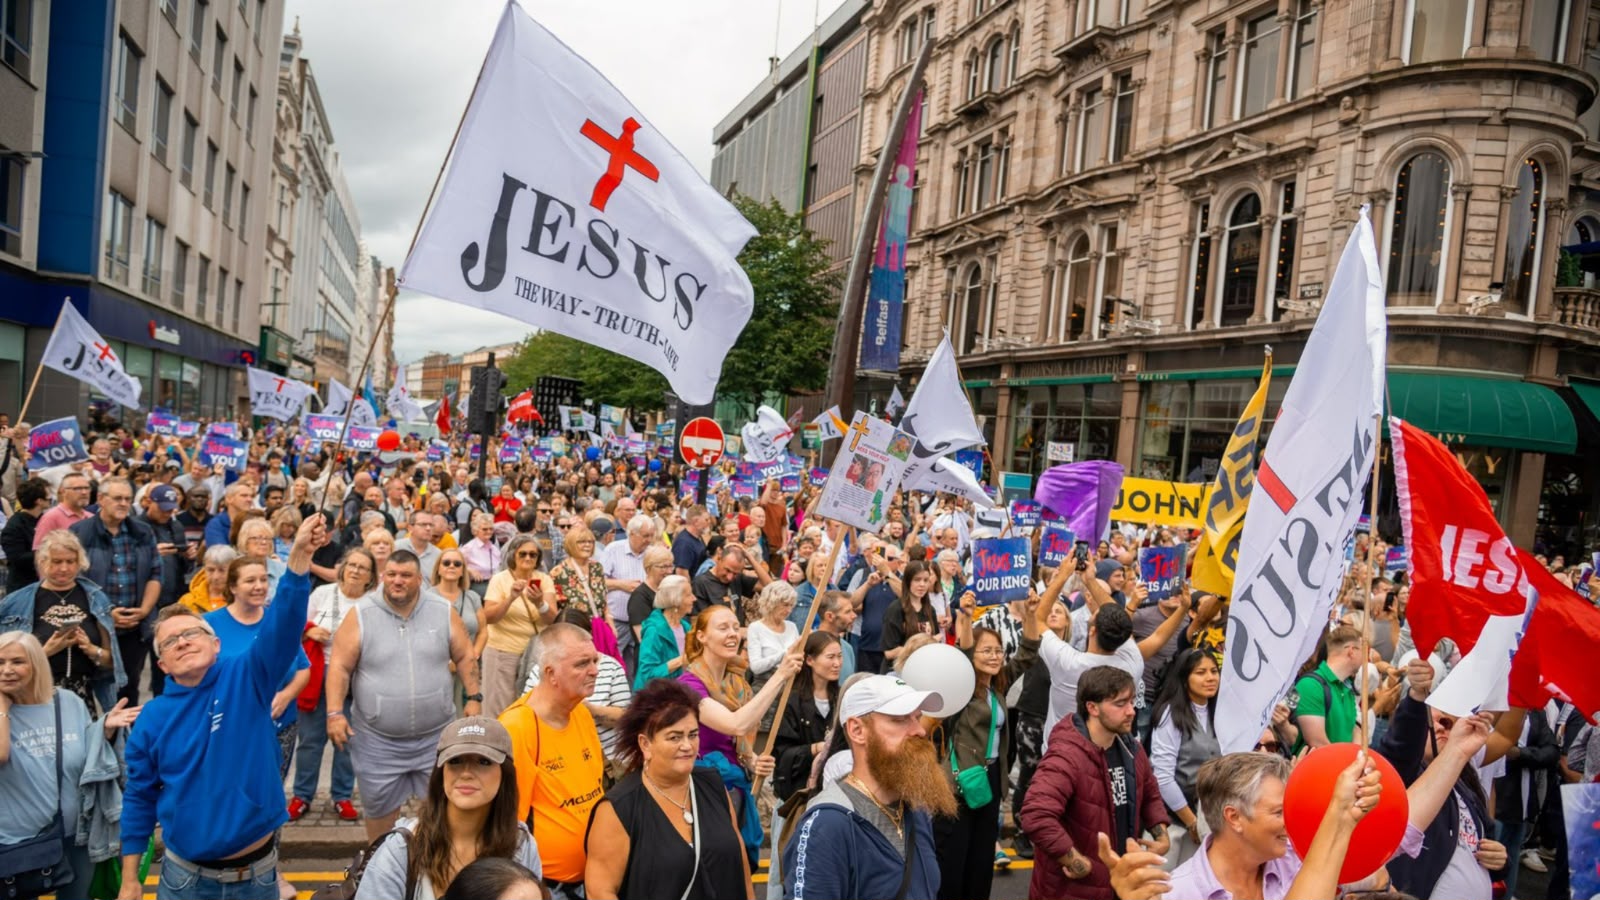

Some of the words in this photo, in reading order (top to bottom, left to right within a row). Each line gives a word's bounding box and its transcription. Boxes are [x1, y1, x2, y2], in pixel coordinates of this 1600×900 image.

[460, 171, 709, 332] JESUS
[514, 275, 542, 304] THE
[541, 284, 583, 317] WAY
[593, 306, 660, 347] TRUTH
[875, 299, 889, 346] Belfast
[314, 428, 340, 439] YOU
[352, 438, 374, 448] YOU
[38, 444, 77, 463] YOU
[210, 453, 238, 468] YOU
[760, 464, 784, 477] YOU
[1113, 490, 1200, 519] JOHN
[976, 547, 1011, 577] Jesus
[1013, 554, 1027, 568] IS
[1044, 552, 1053, 561] IS
[976, 577, 1001, 592] OUR
[1001, 574, 1030, 590] KING
[1148, 580, 1160, 592] IS
